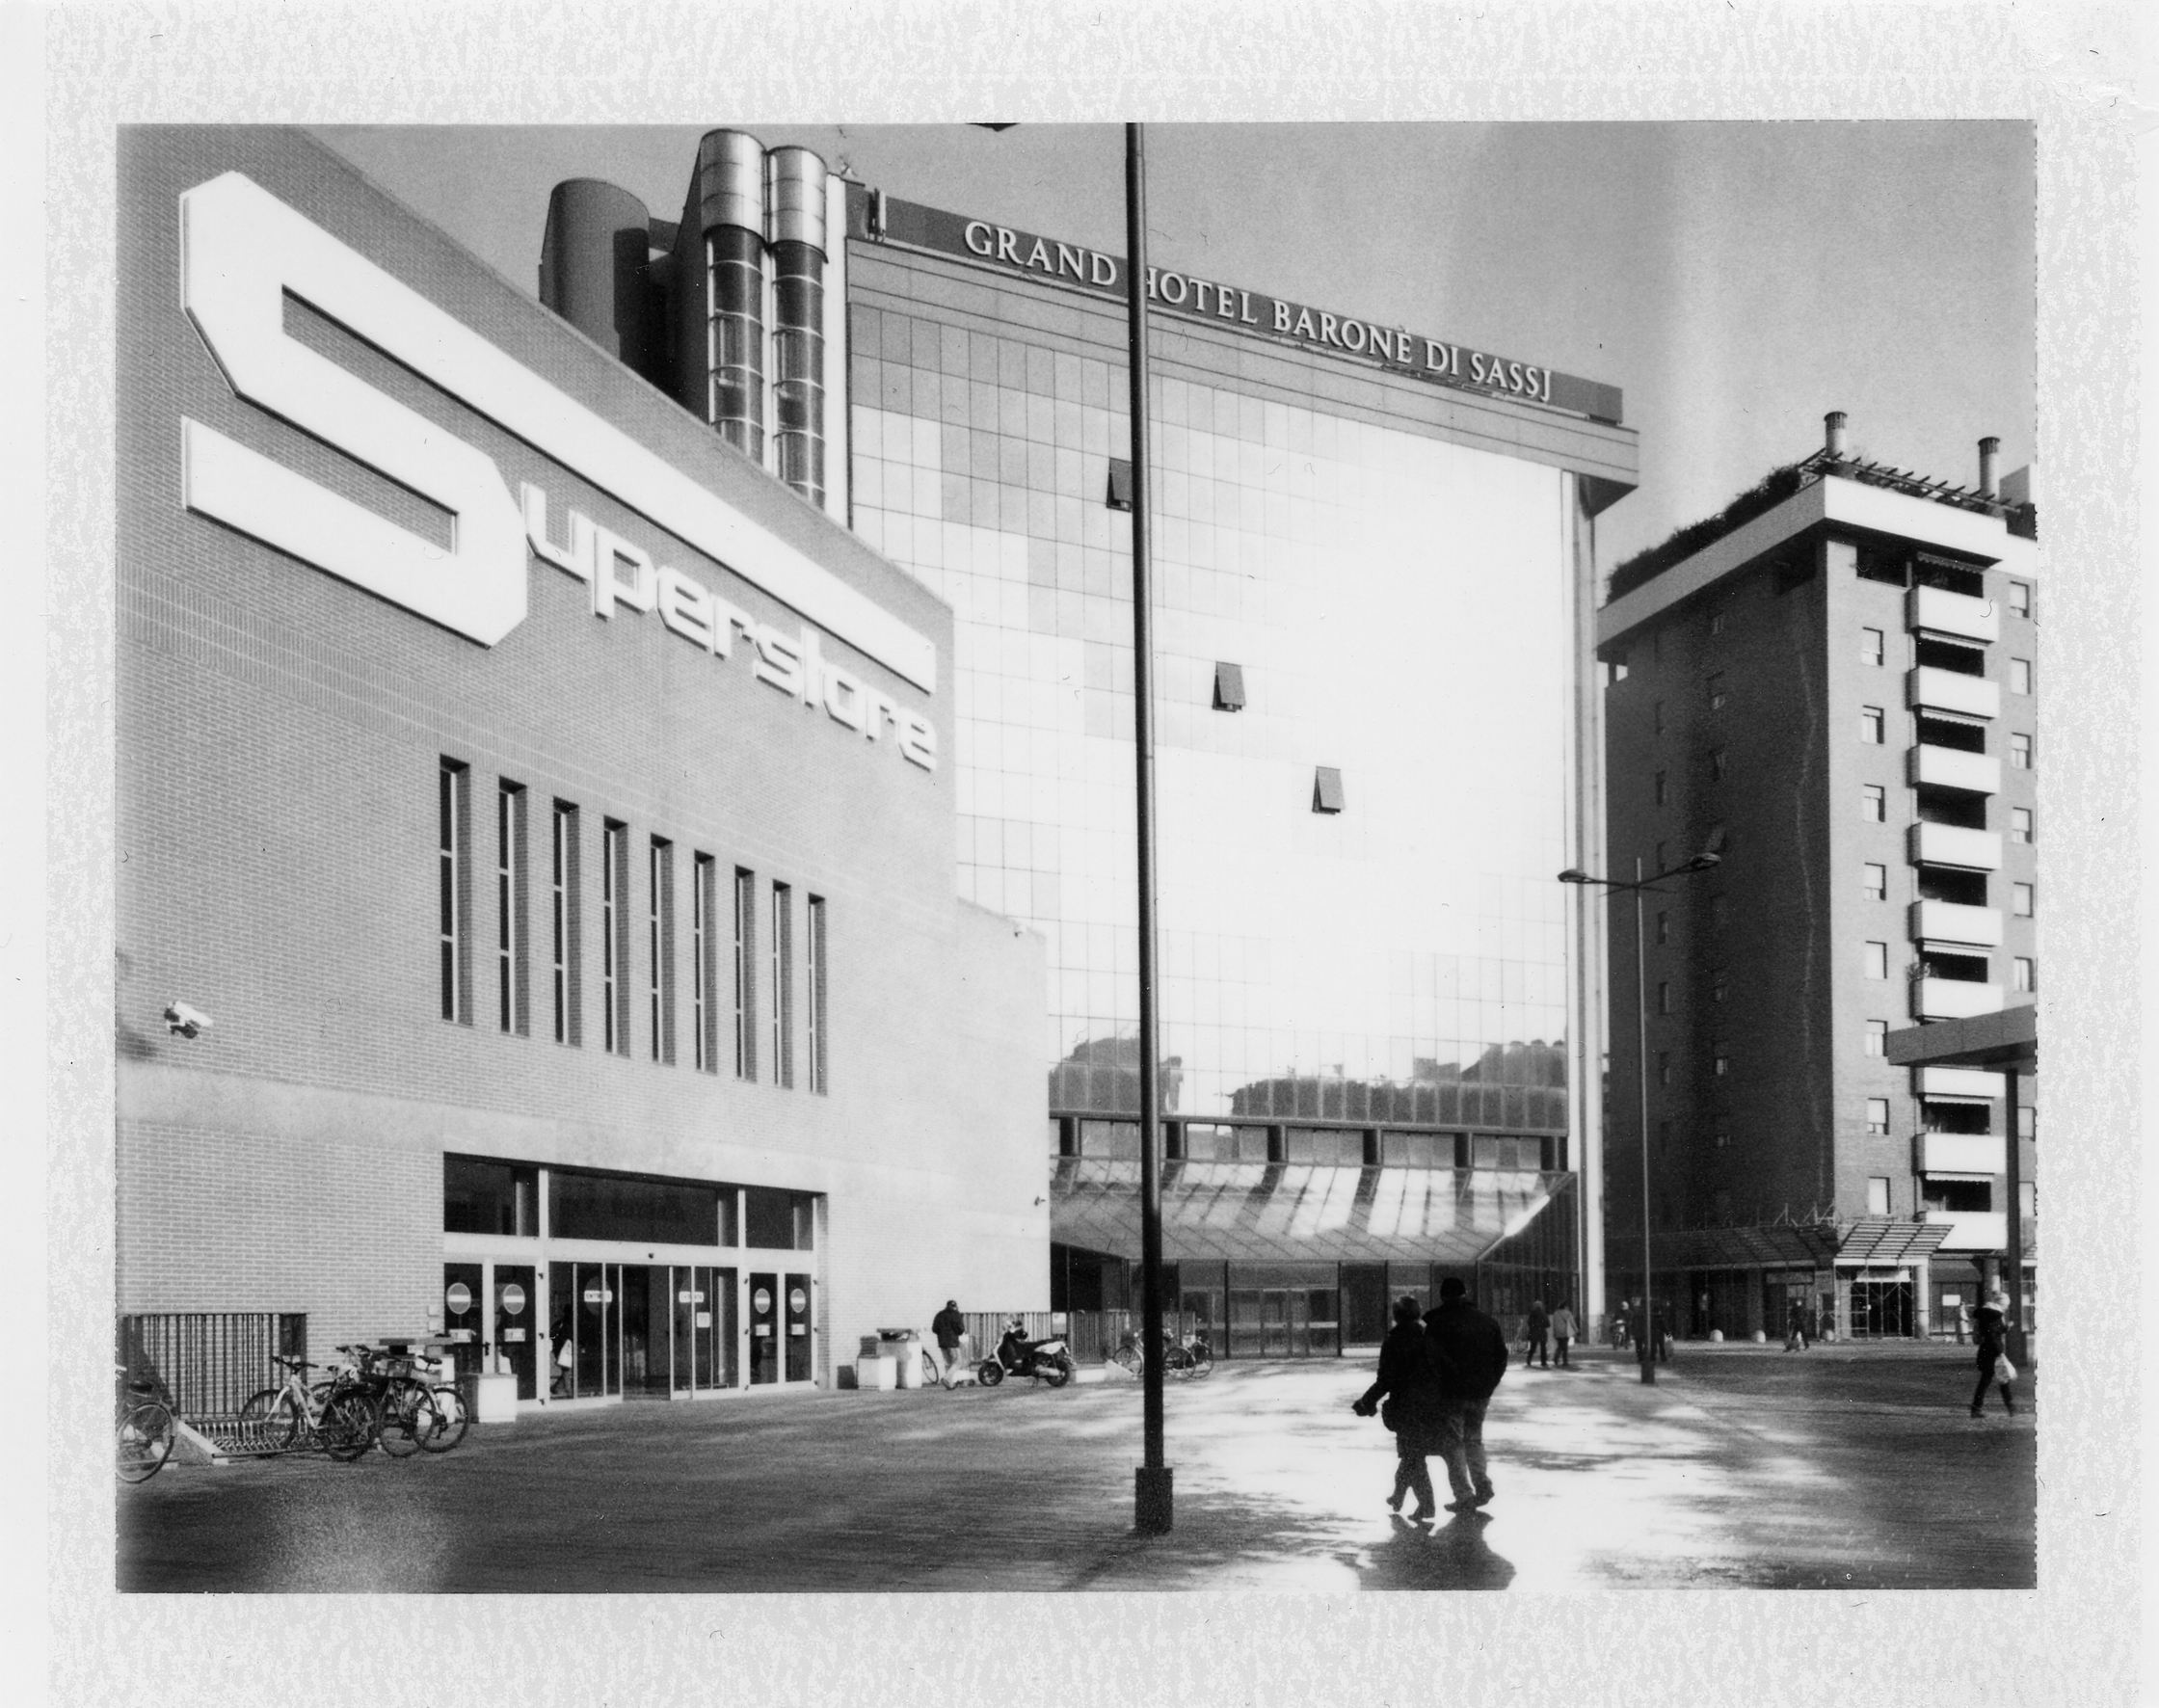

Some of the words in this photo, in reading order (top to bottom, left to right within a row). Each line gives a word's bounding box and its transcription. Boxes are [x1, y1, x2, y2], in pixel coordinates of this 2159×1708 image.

[179, 170, 937, 772] Superstore
[964, 220, 1117, 287] GRAND
[1271, 300, 1413, 364] BARONE
[1426, 339, 1459, 376] DI
